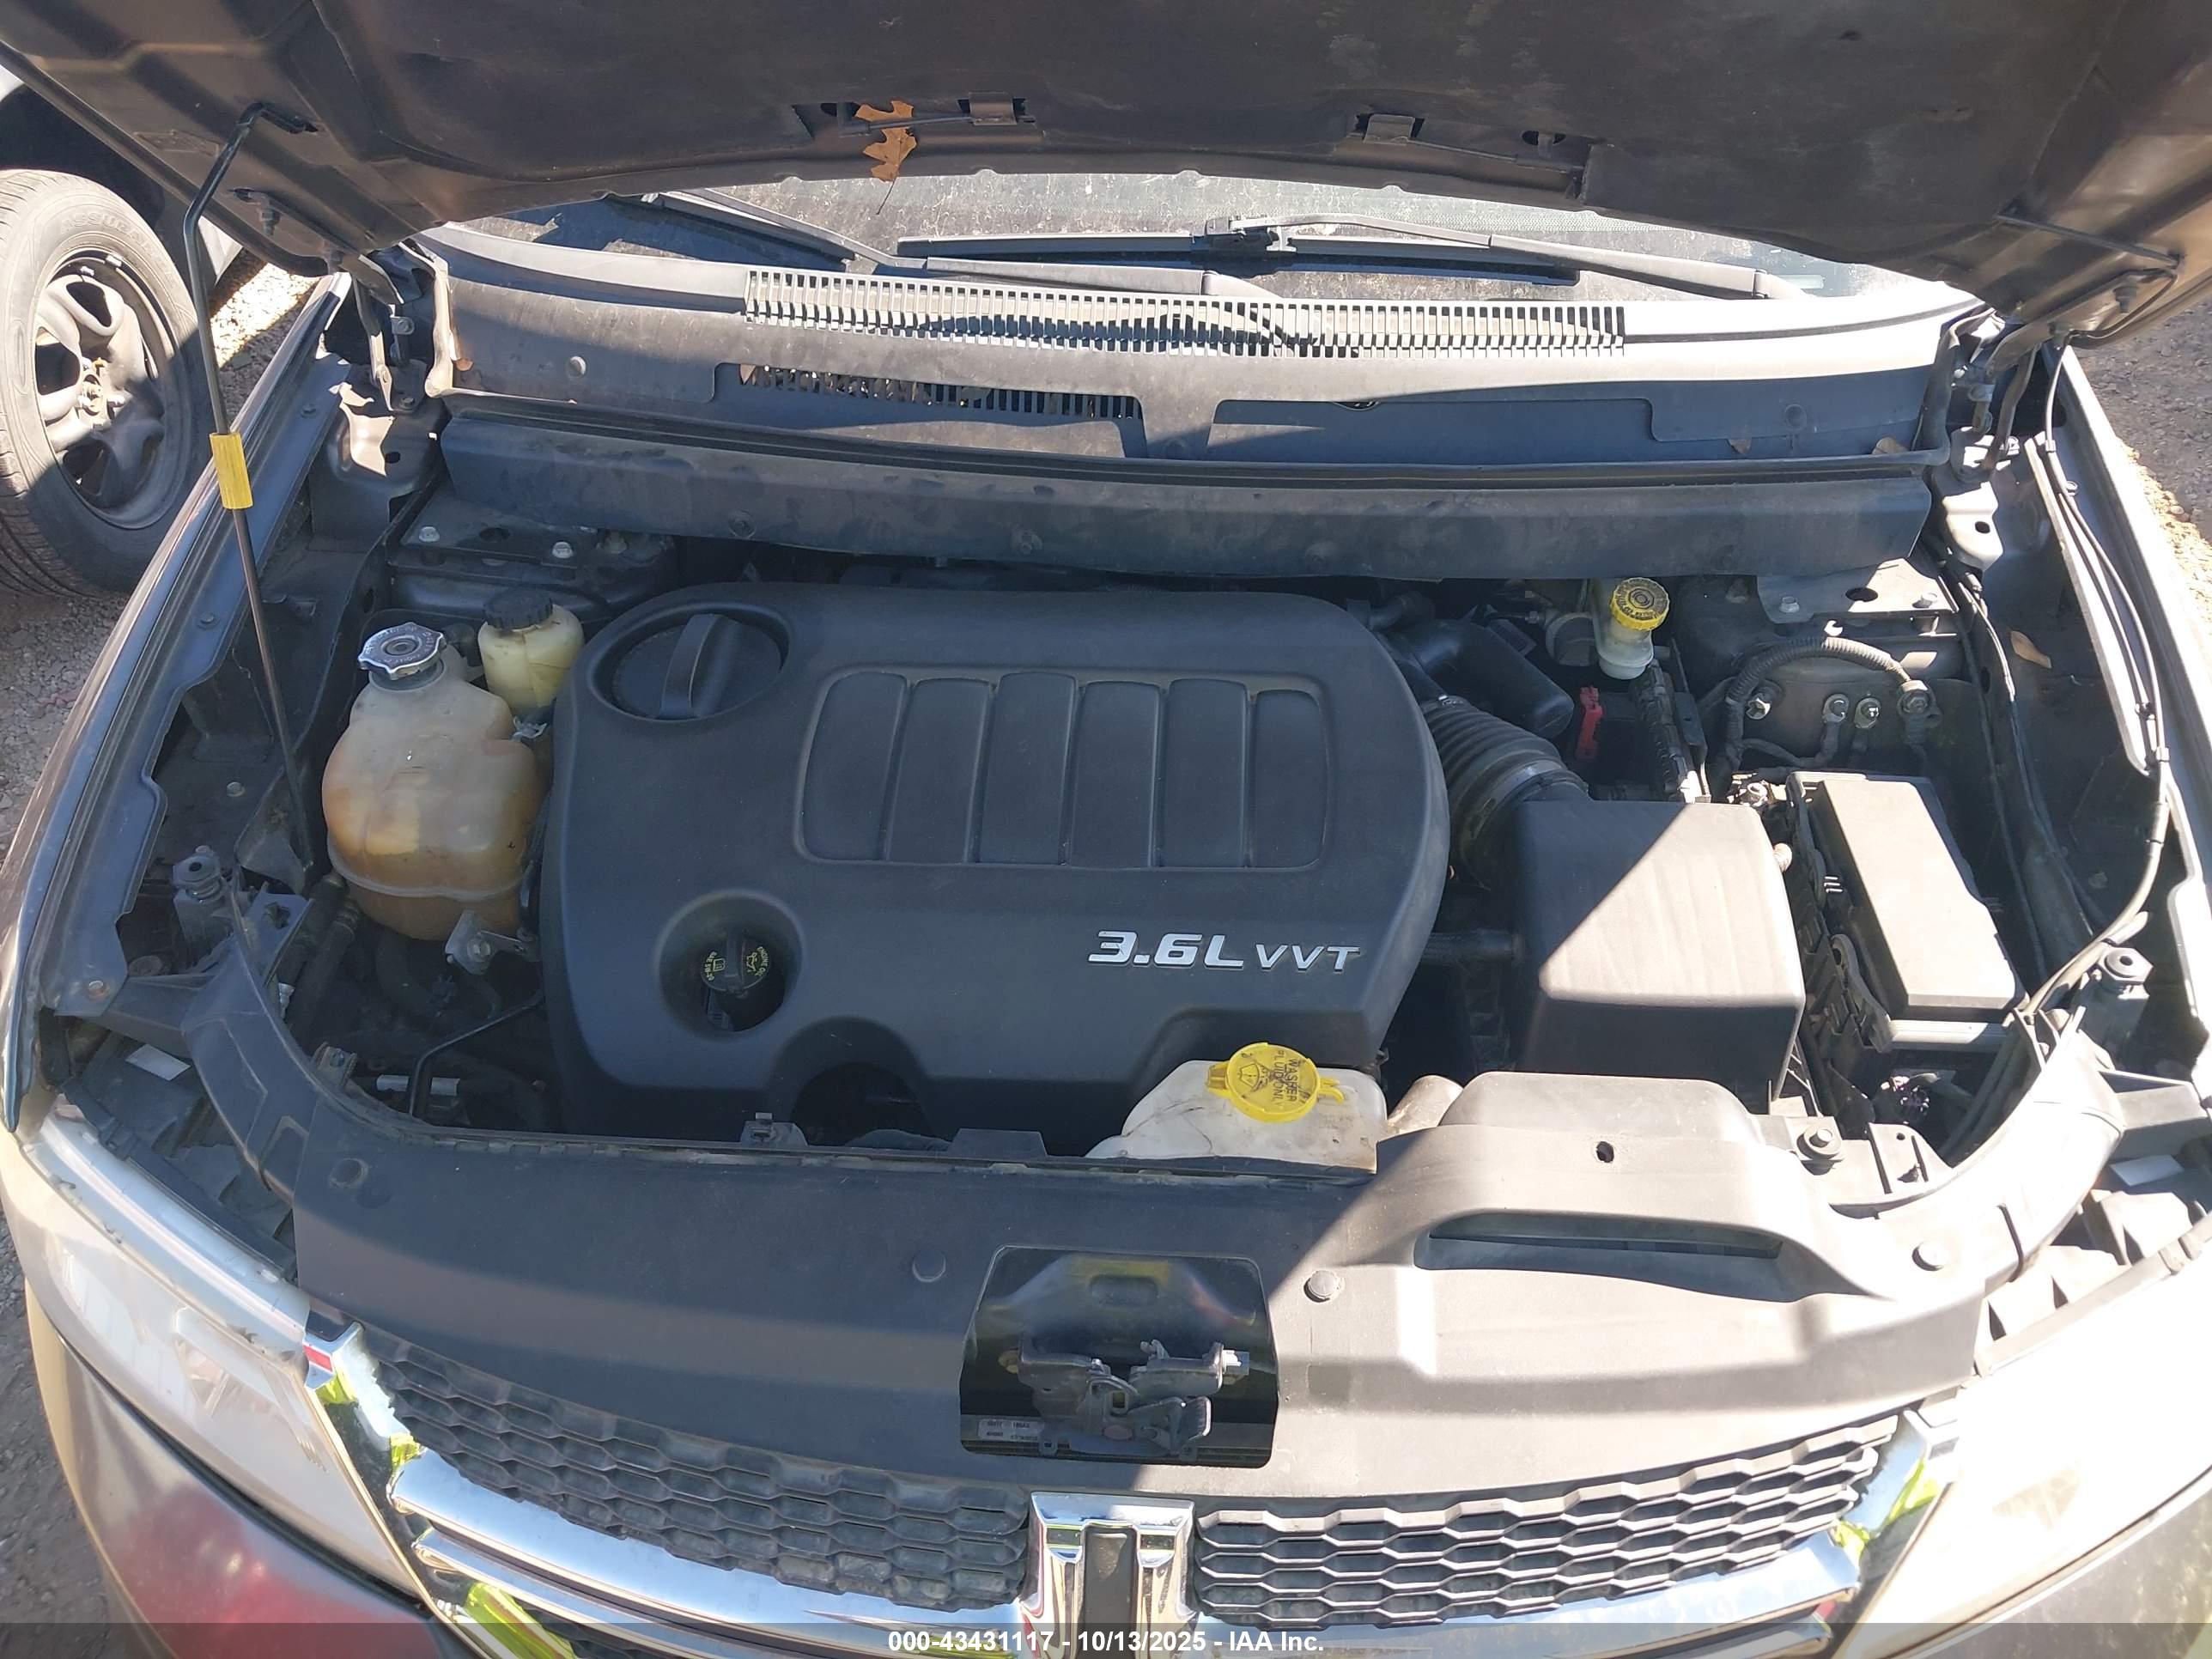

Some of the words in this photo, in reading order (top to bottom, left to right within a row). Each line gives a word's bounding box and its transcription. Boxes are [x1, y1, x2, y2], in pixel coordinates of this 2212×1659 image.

[757, 946, 769, 966] ENGINE
[1088, 931, 1244, 967] 3.6L
[1255, 944, 1361, 970] VVT
[1273, 1049, 1285, 1080] FLUID
[1286, 1058, 1299, 1102] WASHER
[1273, 1082, 1285, 1108] ONLY
